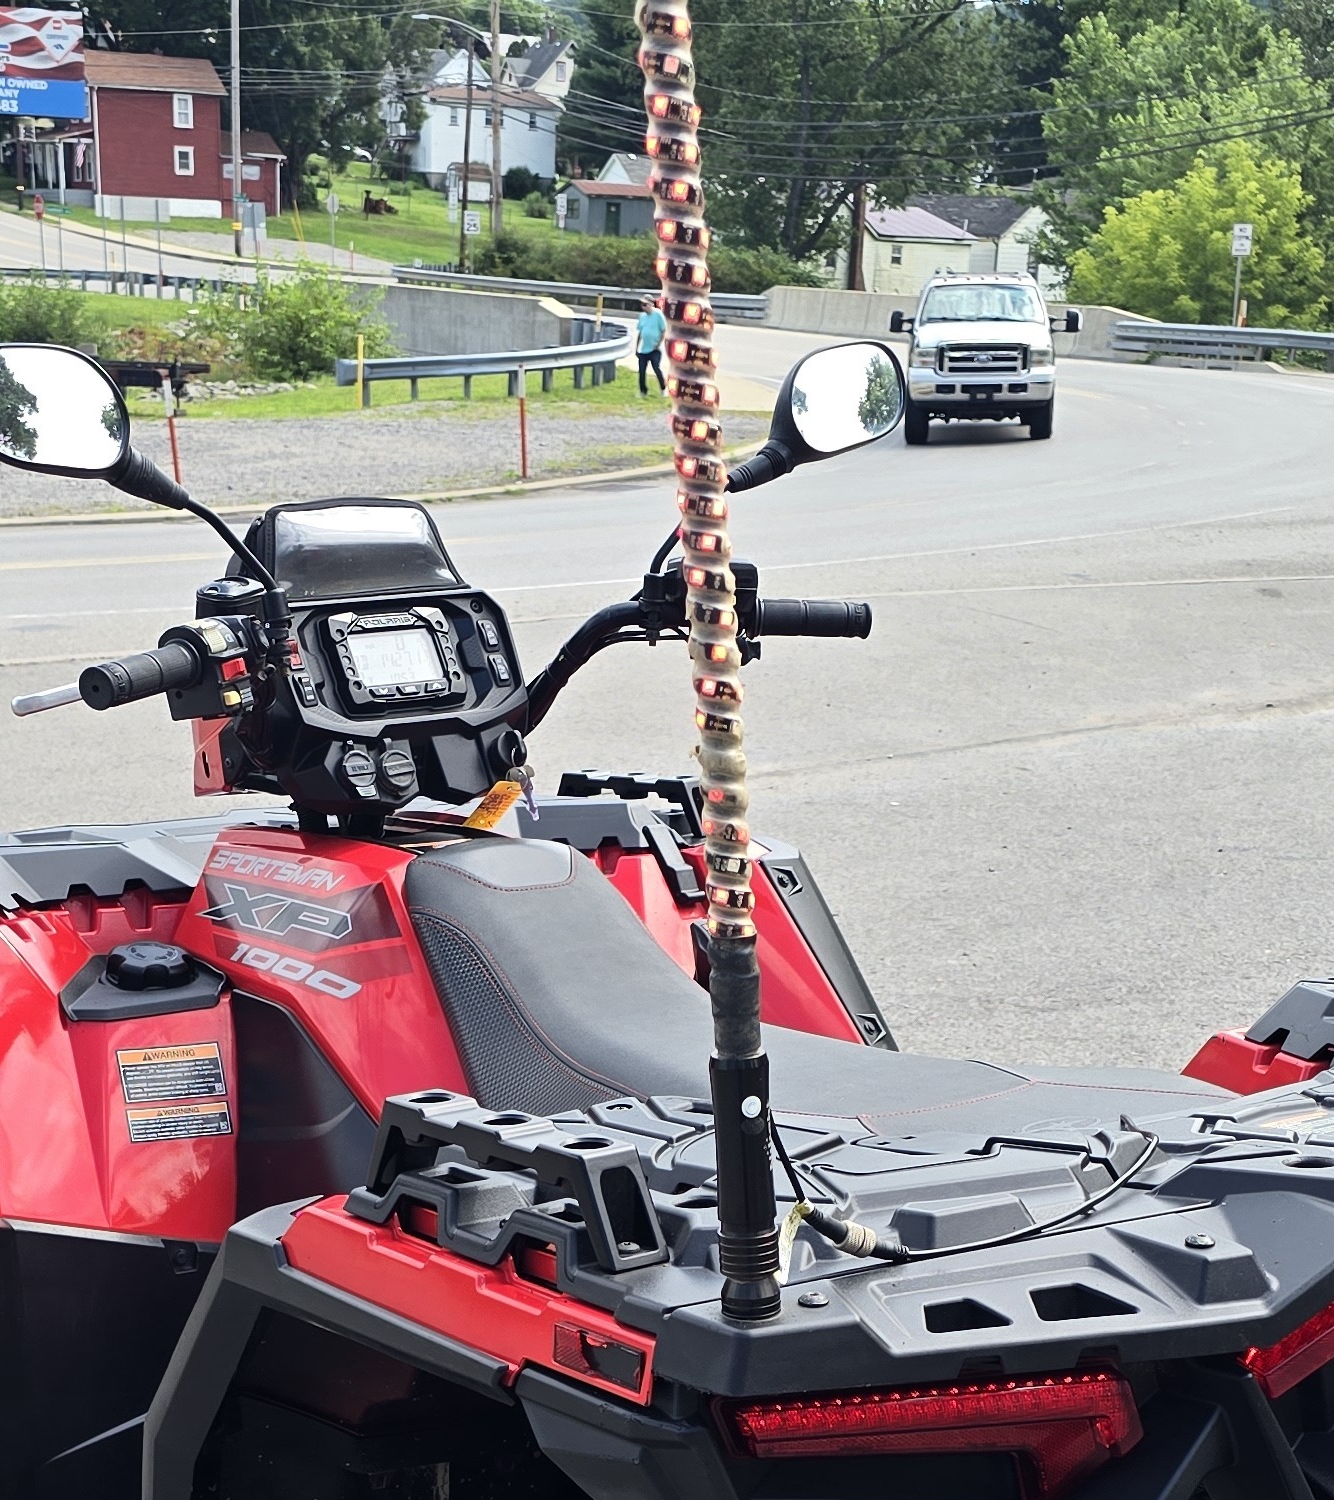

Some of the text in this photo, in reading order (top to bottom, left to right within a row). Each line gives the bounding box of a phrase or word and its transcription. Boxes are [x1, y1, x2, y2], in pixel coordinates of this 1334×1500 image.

[7, 78, 48, 90] OWNED
[209, 850, 345, 891] SPORTSMAN
[195, 883, 352, 939] XP
[230, 943, 362, 999] 1000
[151, 1048, 196, 1060] WARNING
